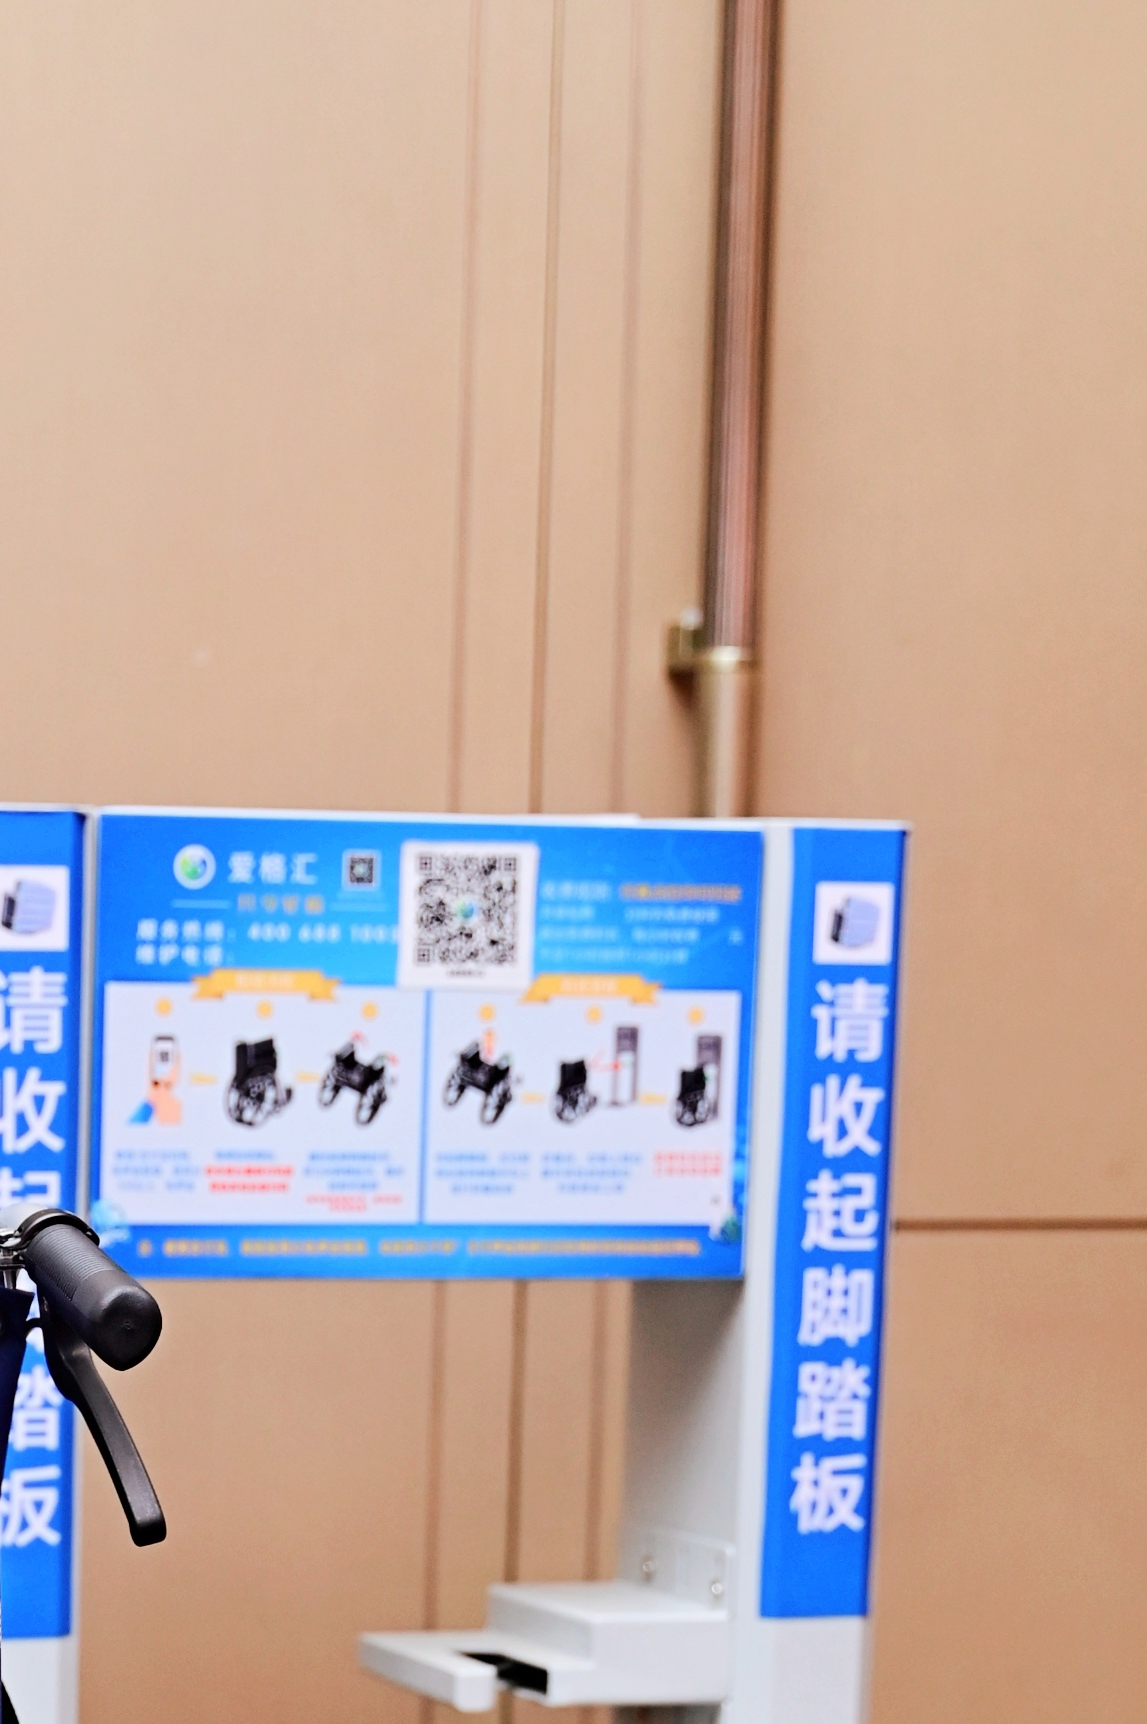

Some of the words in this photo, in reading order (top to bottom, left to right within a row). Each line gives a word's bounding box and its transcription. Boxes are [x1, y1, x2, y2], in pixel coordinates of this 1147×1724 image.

[789, 979, 890, 1535] 请收起脚踏板
